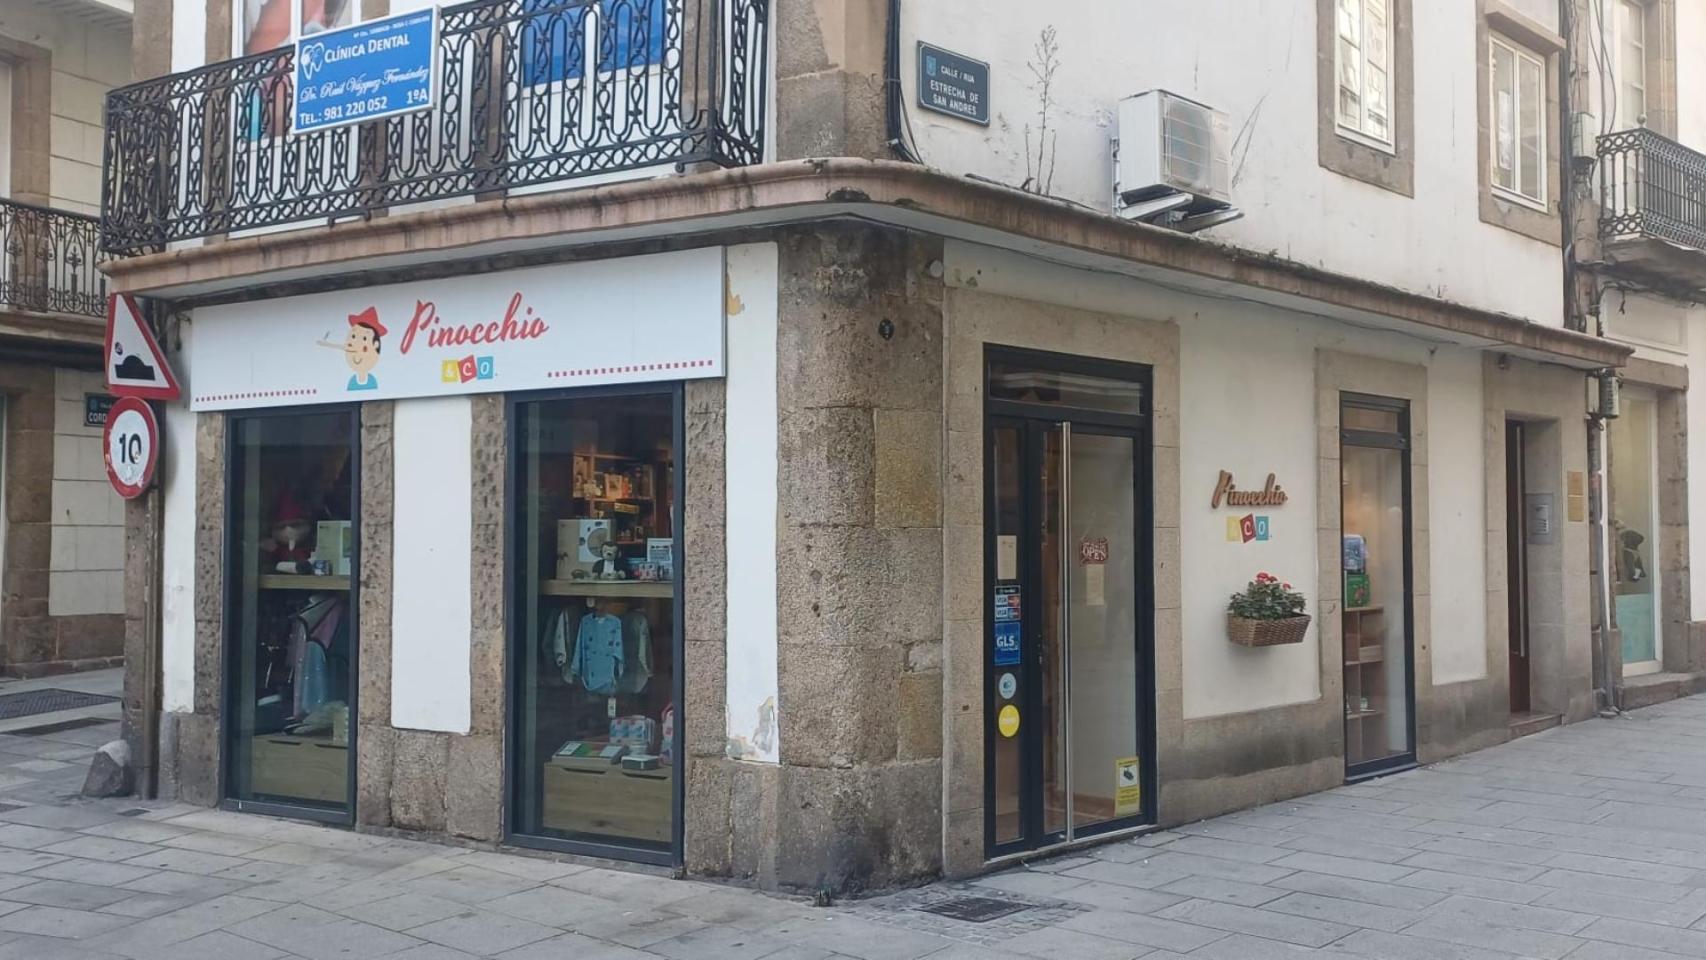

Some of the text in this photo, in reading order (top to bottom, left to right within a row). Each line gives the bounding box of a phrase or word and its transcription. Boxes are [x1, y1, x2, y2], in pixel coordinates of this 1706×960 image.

[324, 33, 410, 64] CLÍNICA DENTAL
[940, 65, 959, 79] CALLE
[930, 80, 979, 104] ESTRECHA DE
[323, 105, 343, 120] 981
[345, 99, 366, 116] 220
[367, 96, 388, 112] 052
[933, 94, 977, 116] SAN ANDRES
[399, 291, 550, 354] Pinocchio
[119, 433, 142, 465] 10
[1211, 469, 1289, 509] Pinocchio
[1082, 545, 1106, 561] OPEN
[996, 635, 1015, 648] GLS
